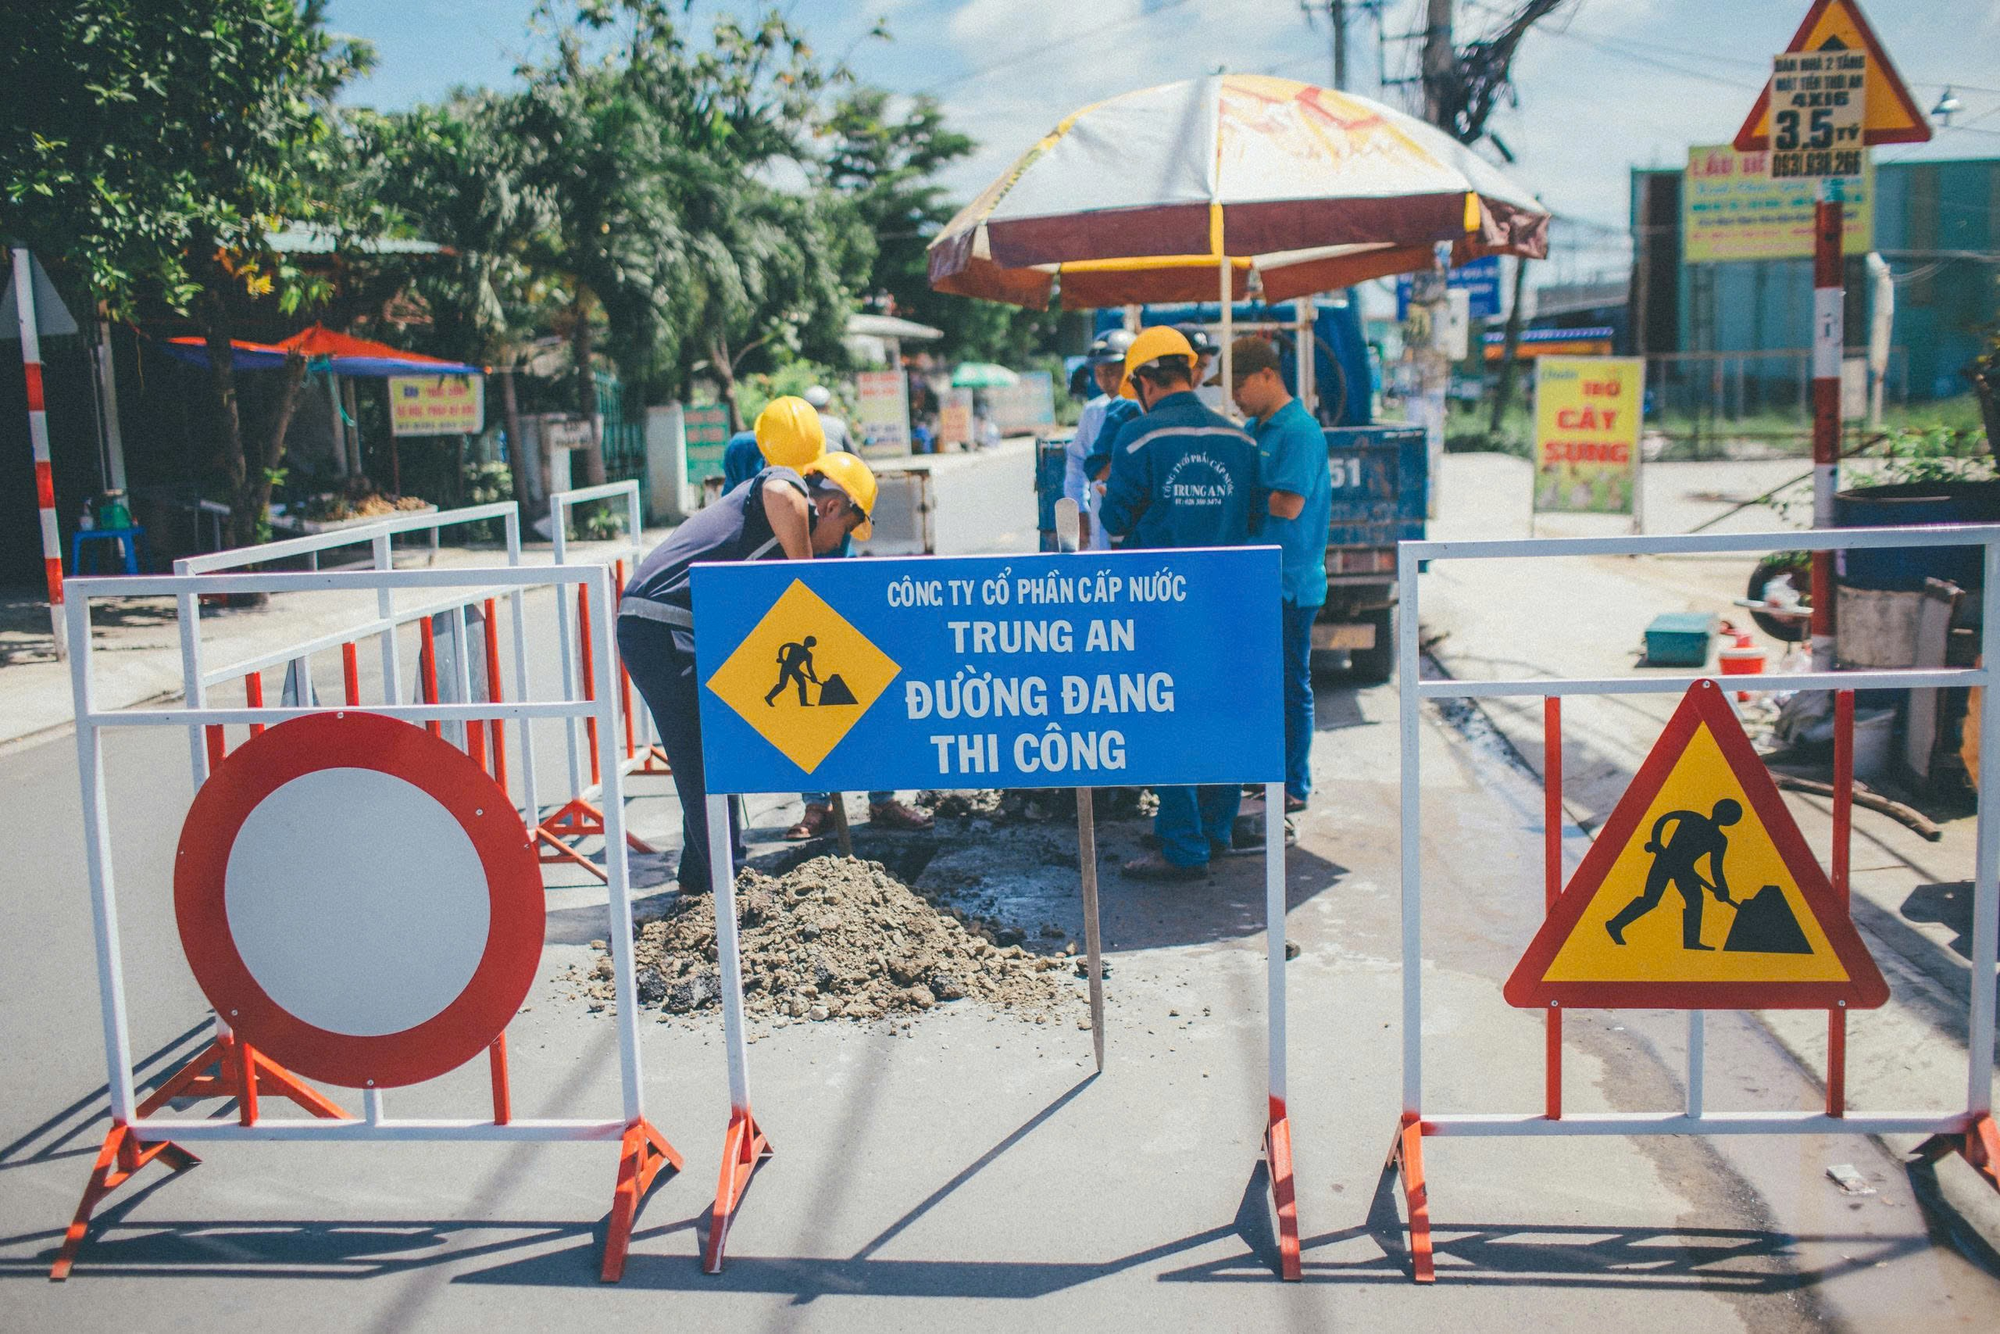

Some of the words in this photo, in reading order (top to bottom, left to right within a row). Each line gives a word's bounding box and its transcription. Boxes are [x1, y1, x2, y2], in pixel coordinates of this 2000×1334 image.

[1825, 56, 1834, 70] 2
[1776, 108, 1834, 150] 3.5
[1173, 484, 1207, 497] TRUNG
[1207, 484, 1226, 497] AN
[887, 575, 943, 607] CÔNG
[948, 579, 975, 606] TY
[982, 566, 1012, 605] CỔ
[1017, 568, 1074, 604] PHẦN
[1078, 568, 1122, 603] CẤP
[1129, 566, 1187, 602] NƯỚC
[947, 620, 1073, 654] TRUNG
[1085, 618, 1135, 652] AN
[905, 664, 1048, 720] ĐƯỜNG
[1060, 672, 1175, 715] ĐANG
[929, 733, 999, 774] THI
[1013, 722, 1126, 773] CÔNG
